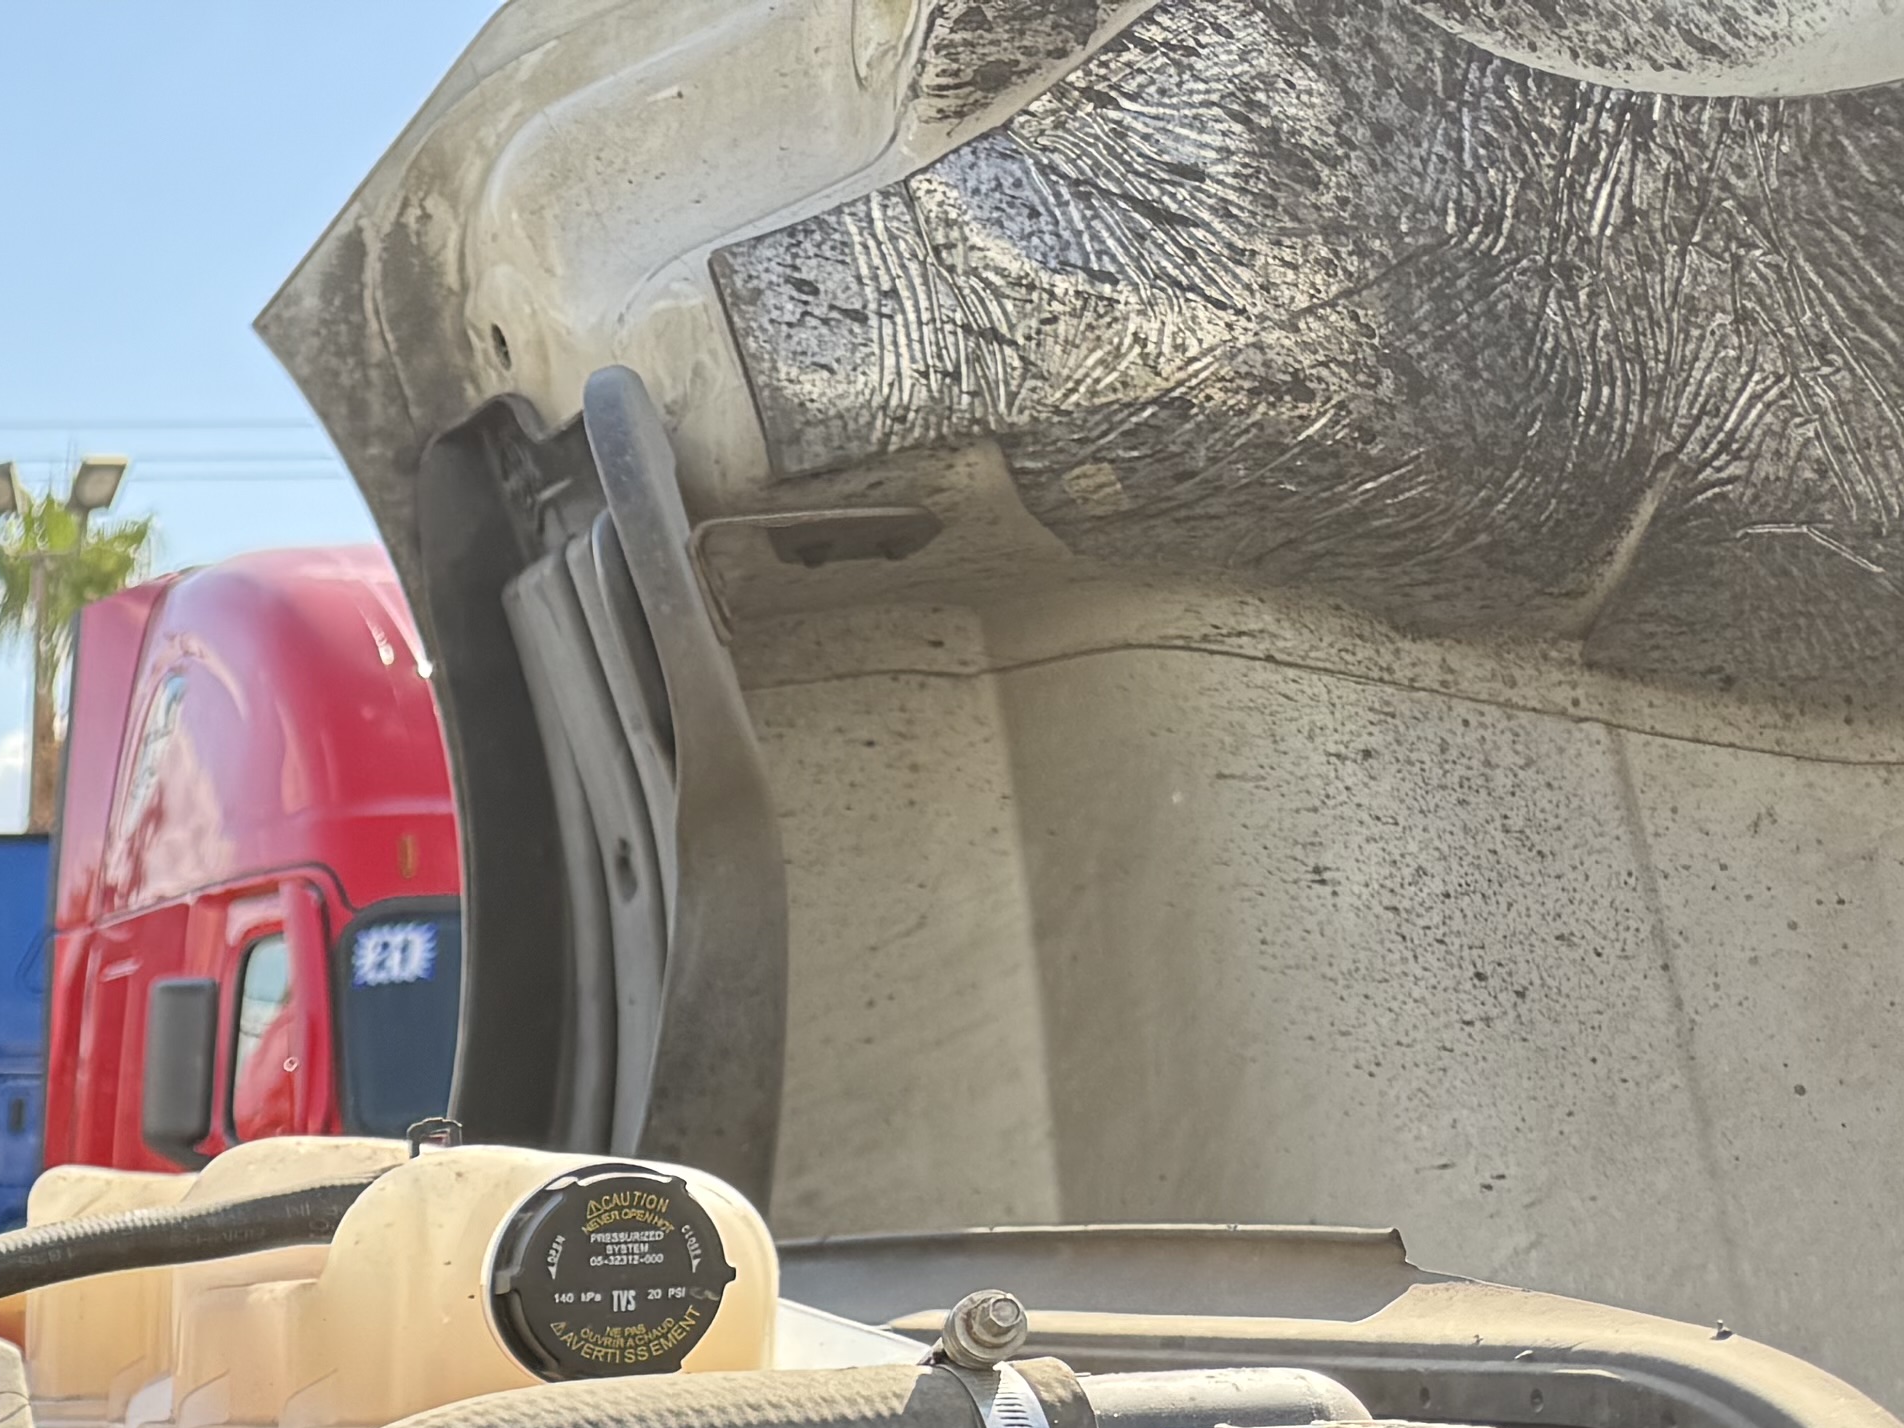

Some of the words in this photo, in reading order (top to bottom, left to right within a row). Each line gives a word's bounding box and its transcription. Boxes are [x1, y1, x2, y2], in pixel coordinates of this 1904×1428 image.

[601, 1190, 670, 1213] CAUTION
[581, 1209, 620, 1235] NEVER
[621, 1208, 654, 1224] OPEN
[652, 1216, 676, 1234] HOT
[590, 1230, 665, 1243] PRESSURIZED
[546, 1234, 566, 1264] OPEN
[605, 1243, 649, 1255] SYSTEM
[554, 1292, 575, 1304] 140
[611, 1289, 637, 1313] TVS
[647, 1288, 662, 1300] 20
[667, 1286, 686, 1299] PSI
[580, 1327, 625, 1349] OUVRIR
[635, 1317, 675, 1346] CHAUD
[605, 1325, 622, 1338] NE
[624, 1323, 647, 1337] PAS
